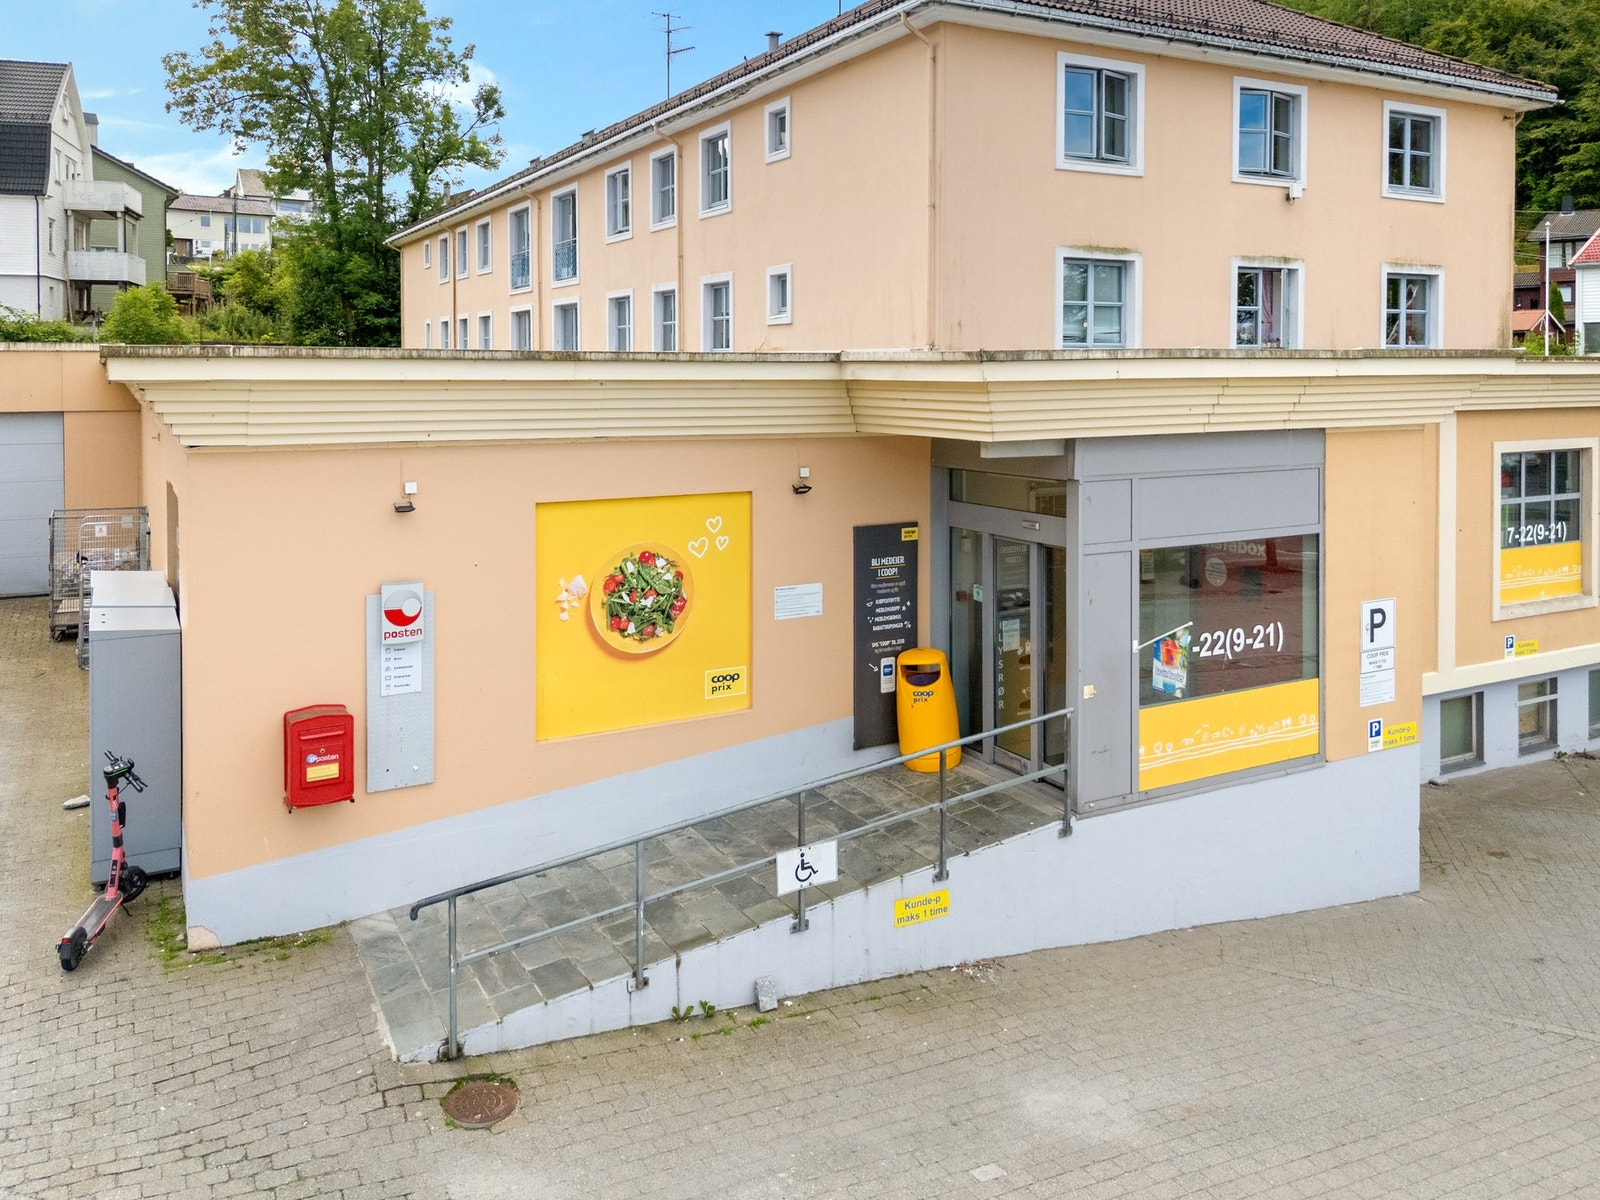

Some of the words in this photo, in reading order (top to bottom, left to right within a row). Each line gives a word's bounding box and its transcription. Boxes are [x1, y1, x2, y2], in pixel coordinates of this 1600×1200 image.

[1507, 521, 1567, 544] 7-22(9-21)
[871, 558, 881, 566] BLI
[881, 556, 905, 566] MEDEIER
[881, 568, 898, 577] COOP!
[1370, 608, 1386, 643] P
[383, 628, 422, 640] posten
[1507, 637, 1513, 648] P
[711, 673, 740, 684] coop
[711, 682, 732, 694] prix
[1372, 723, 1379, 736] P
[315, 754, 340, 762] posten
[904, 895, 941, 910] Kunde-p
[897, 912, 920, 924] maks
[923, 909, 927, 917] 1
[930, 905, 949, 916] time
